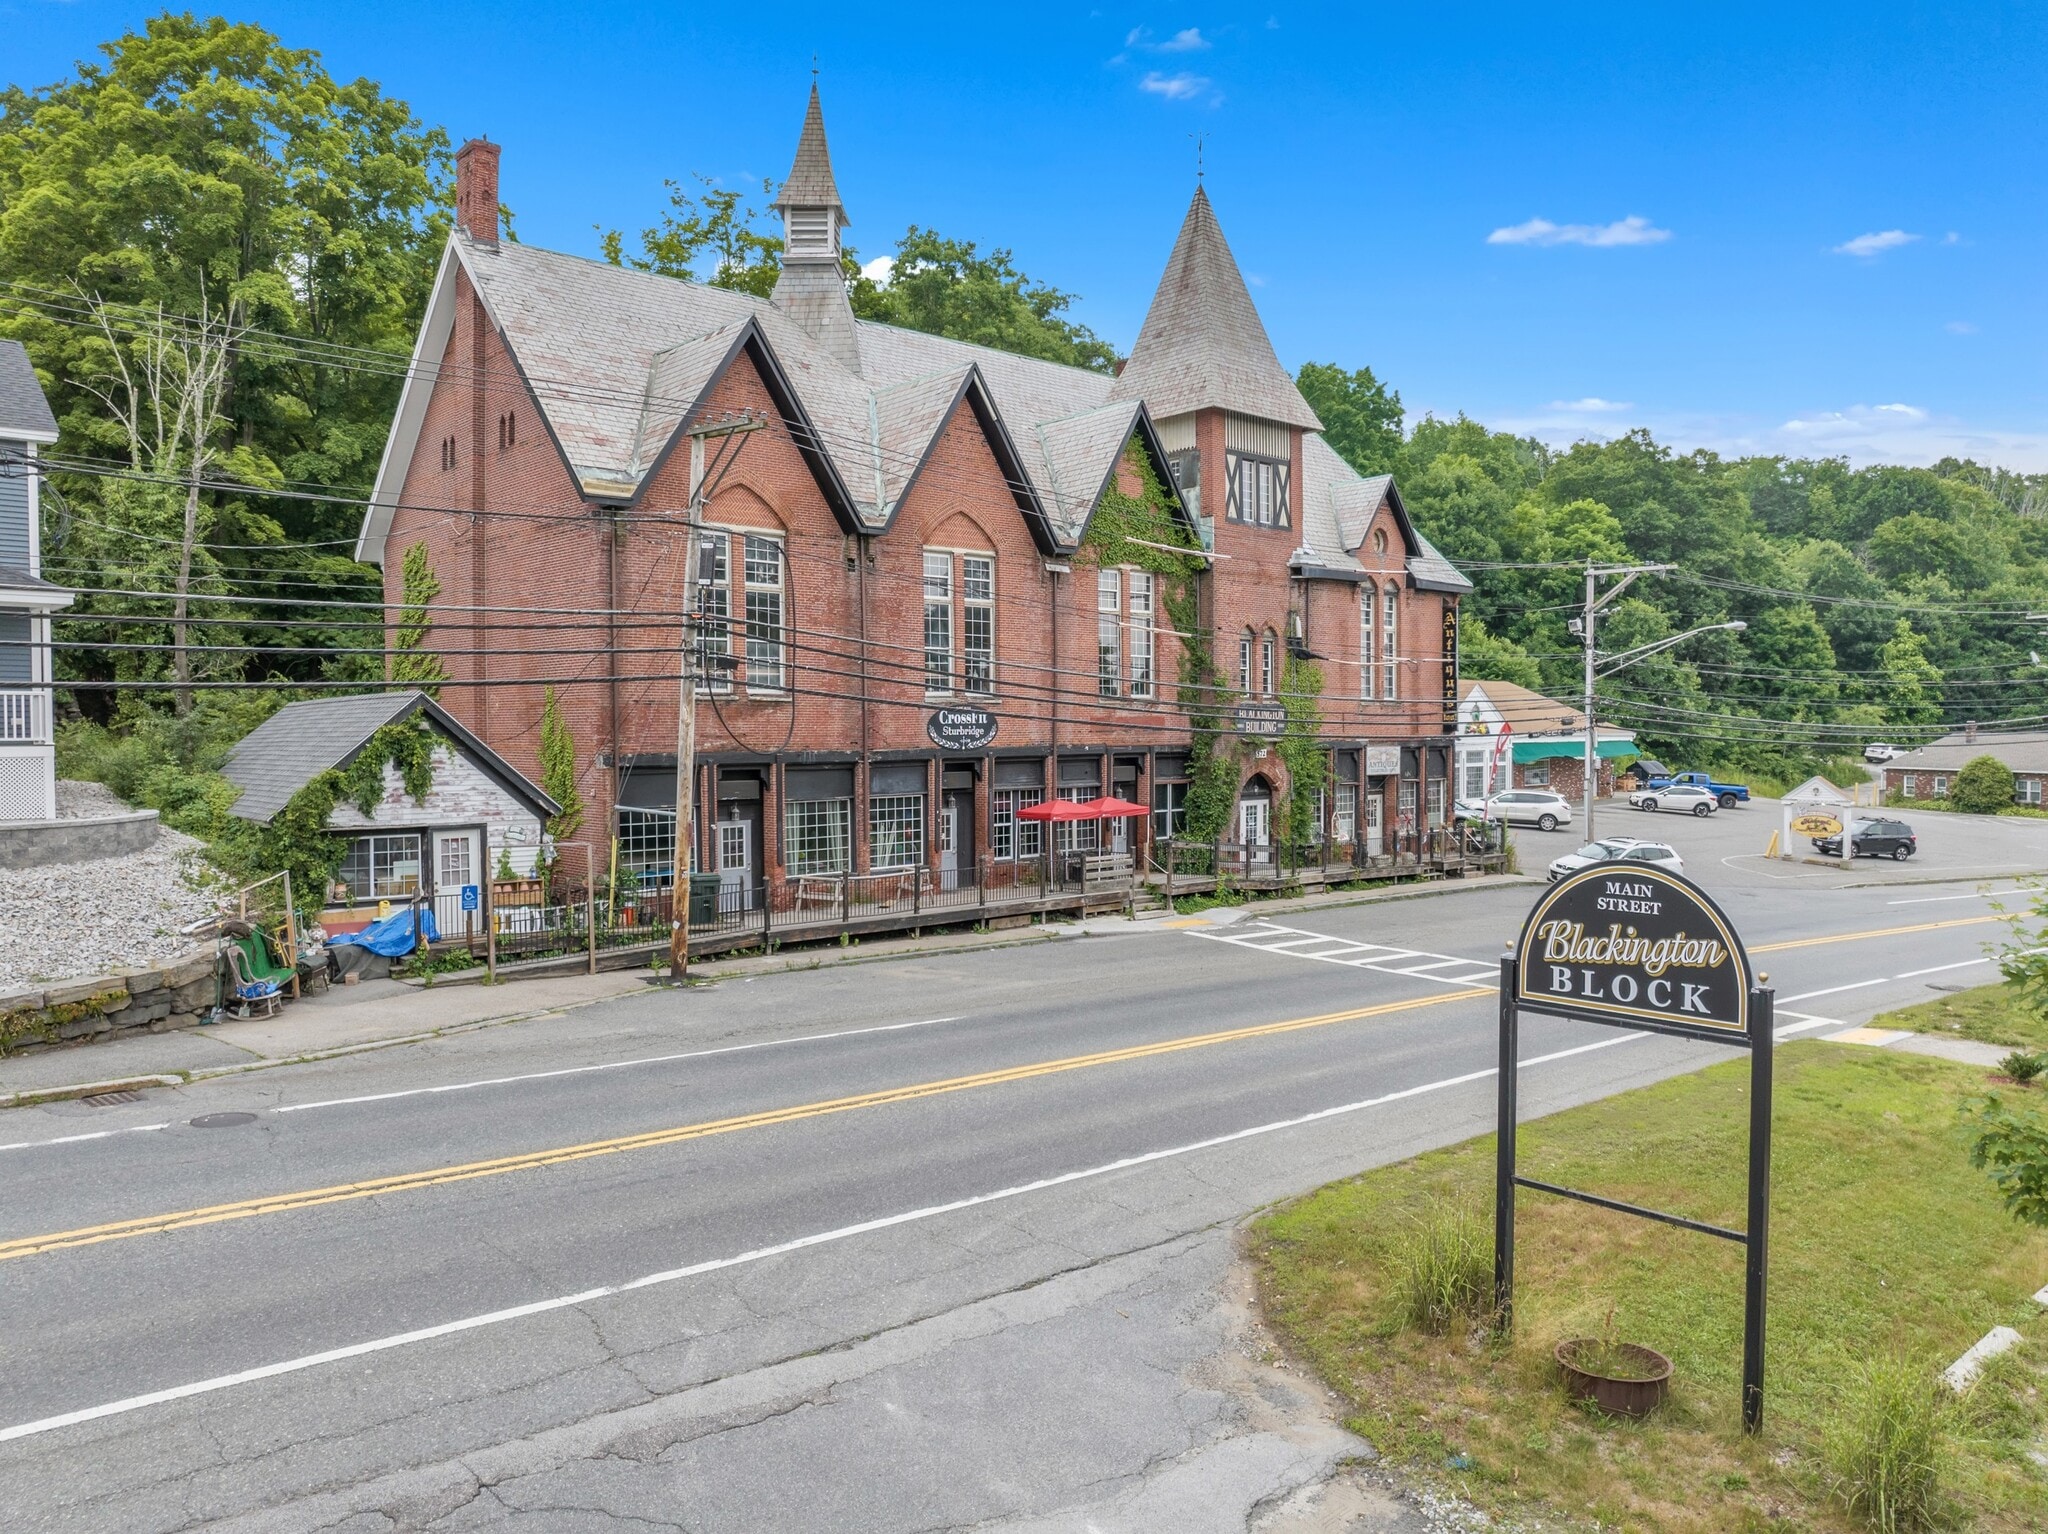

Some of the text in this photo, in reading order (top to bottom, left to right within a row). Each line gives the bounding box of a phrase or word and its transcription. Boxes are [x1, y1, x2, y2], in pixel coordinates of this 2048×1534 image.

[939, 710, 987, 724] CrossFit
[942, 726, 984, 738] Sturbridge
[1245, 721, 1277, 733] BUILDING
[1606, 881, 1653, 898] MAIN
[1597, 898, 1662, 915] STREET
[1538, 919, 1727, 977] Blackington
[1550, 965, 1711, 1014] BLOCK
